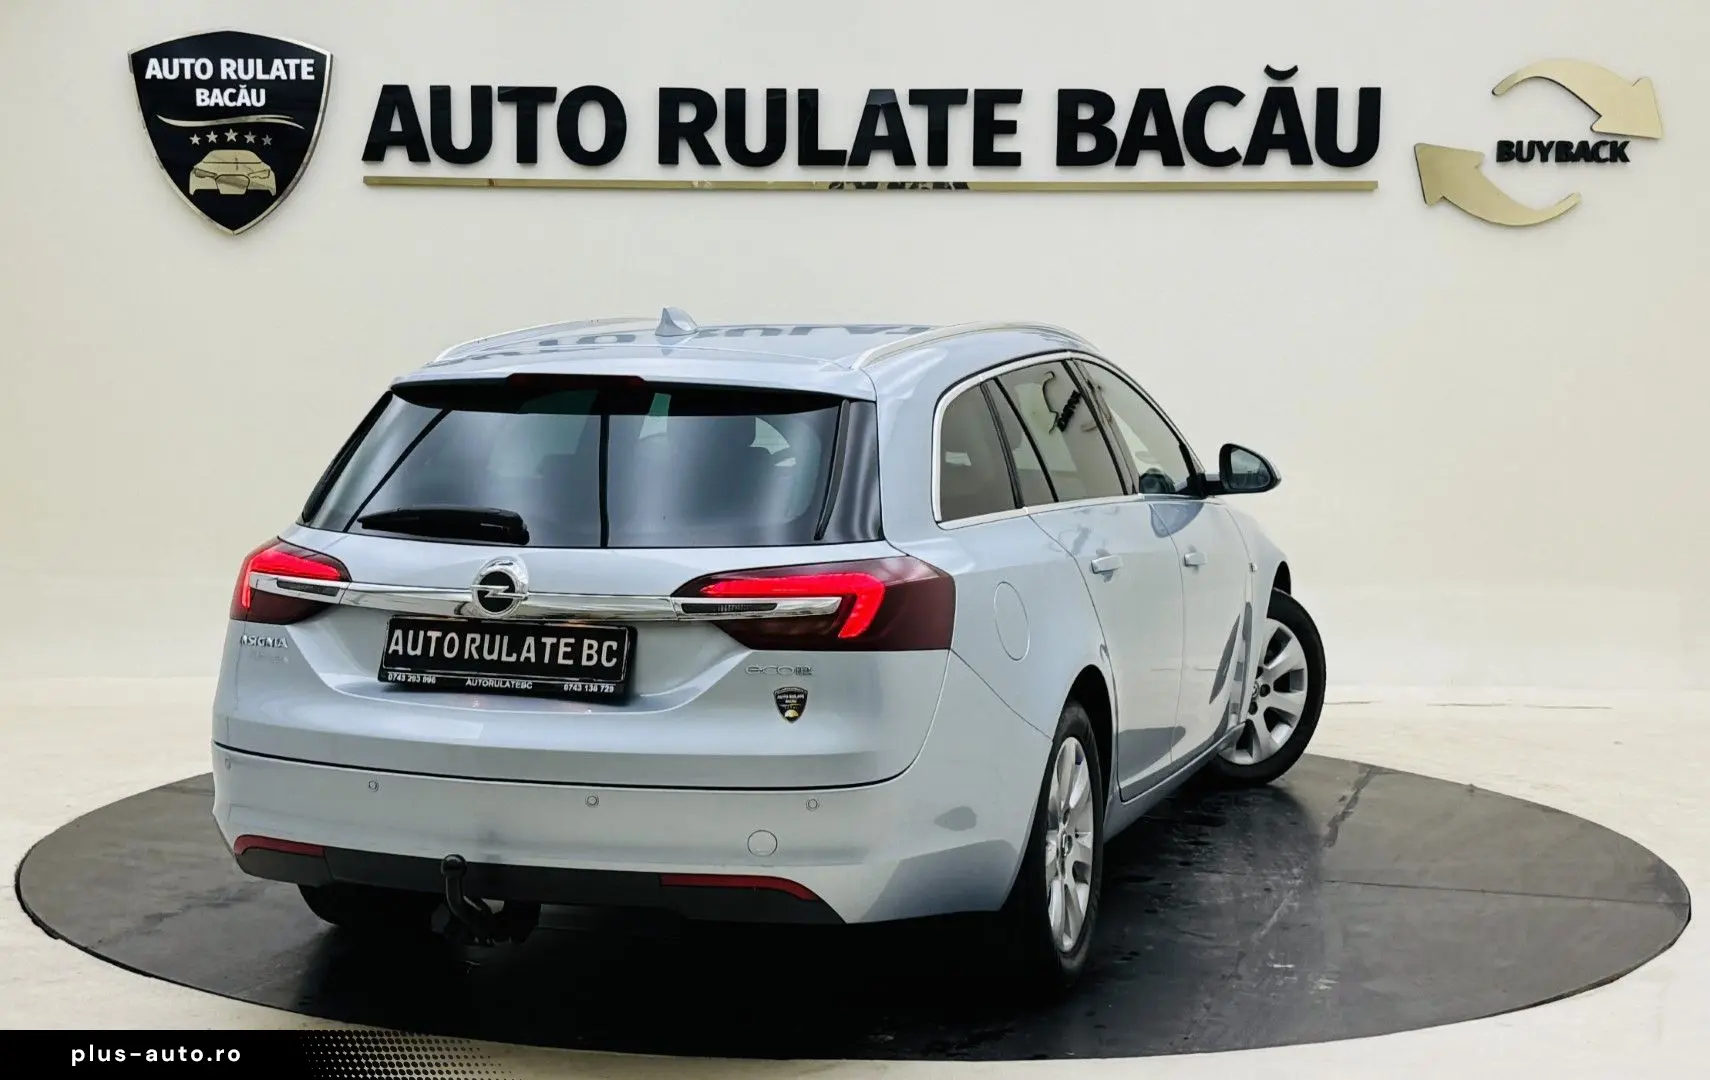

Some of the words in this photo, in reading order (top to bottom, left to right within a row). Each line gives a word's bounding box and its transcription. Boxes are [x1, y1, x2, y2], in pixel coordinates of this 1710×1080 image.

[145, 58, 214, 80] AUTO
[220, 58, 315, 81] RULATE
[195, 84, 266, 108] BACĂU
[361, 84, 627, 167] AUTO
[658, 87, 1023, 168] RULATE
[1056, 64, 1382, 168] BACĂU
[1496, 140, 1631, 163] BUYBACK
[581, 638, 618, 667] BC
[465, 678, 533, 690] AUTORULATEBC
